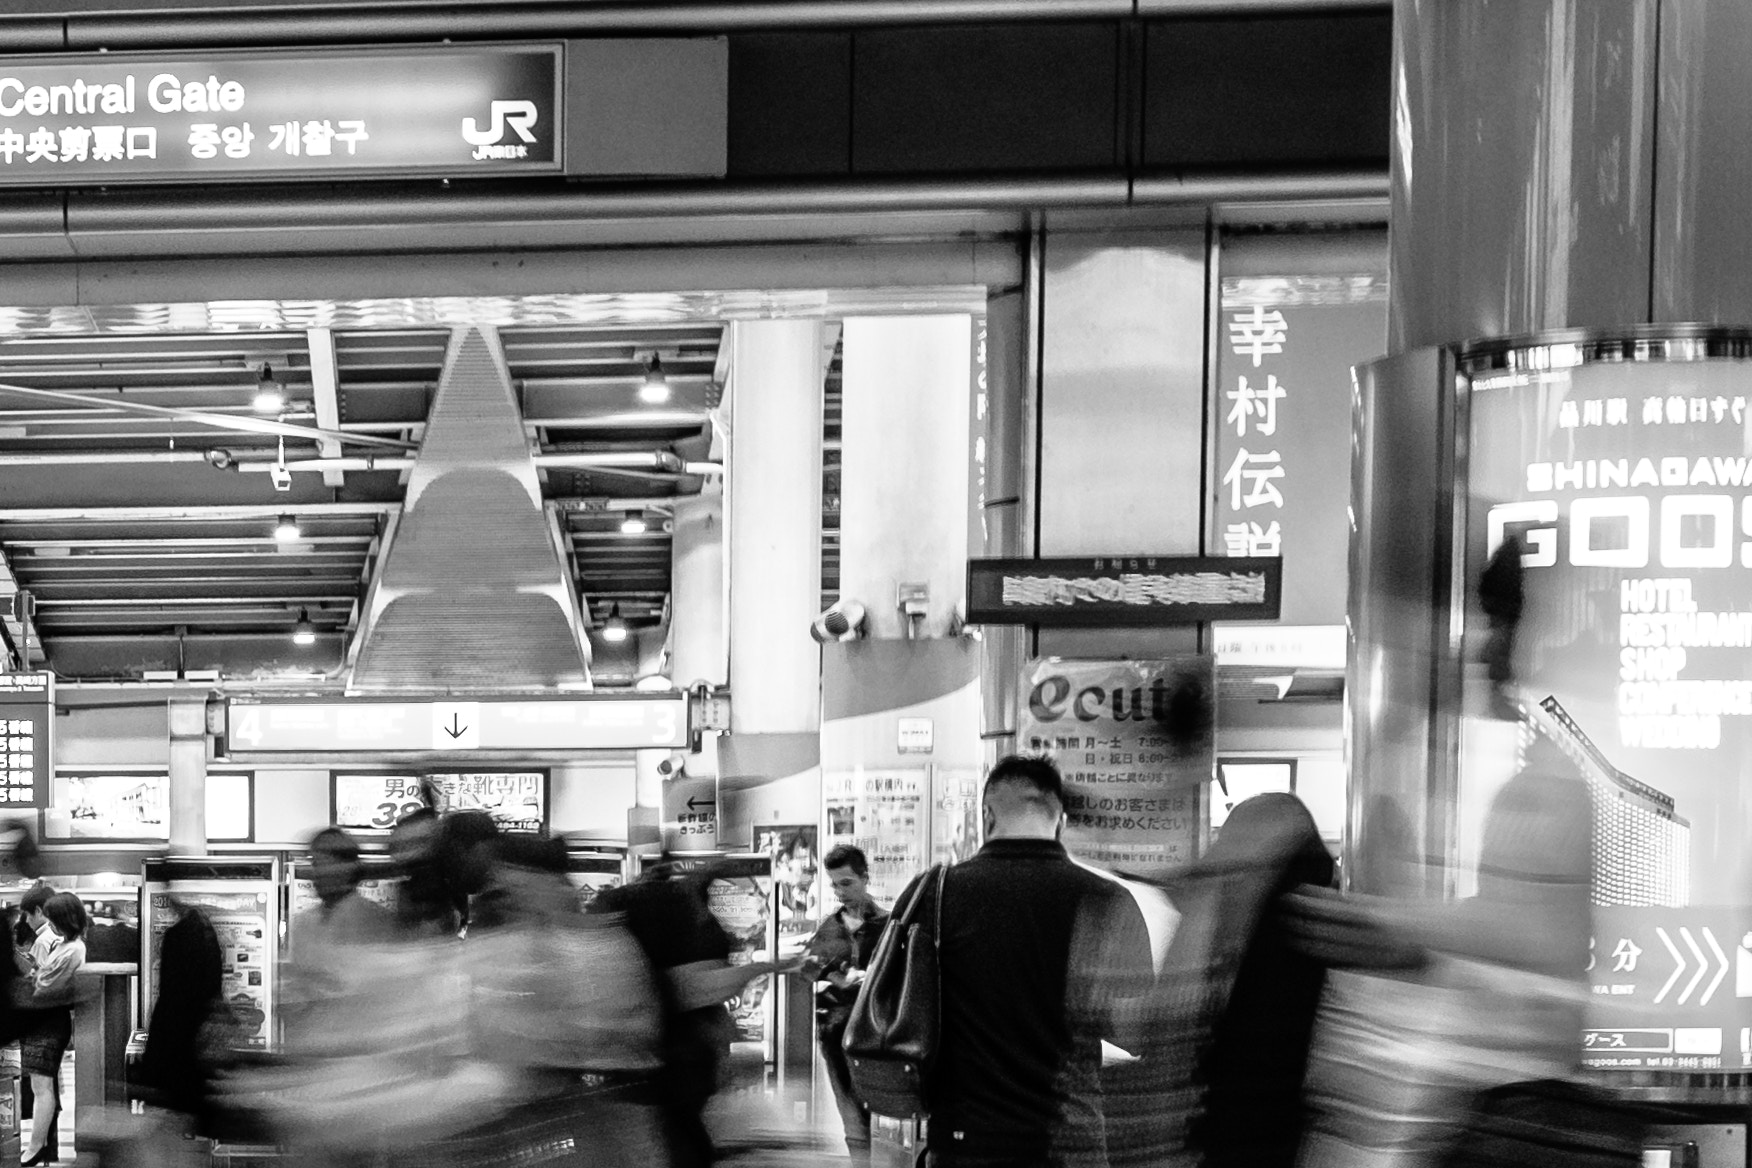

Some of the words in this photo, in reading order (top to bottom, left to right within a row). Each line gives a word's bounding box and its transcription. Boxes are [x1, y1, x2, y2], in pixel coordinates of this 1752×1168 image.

[147, 74, 245, 115] Gate
[462, 101, 538, 145] JR
[1488, 495, 1752, 568] GOO
[1029, 675, 1173, 722] ecut
